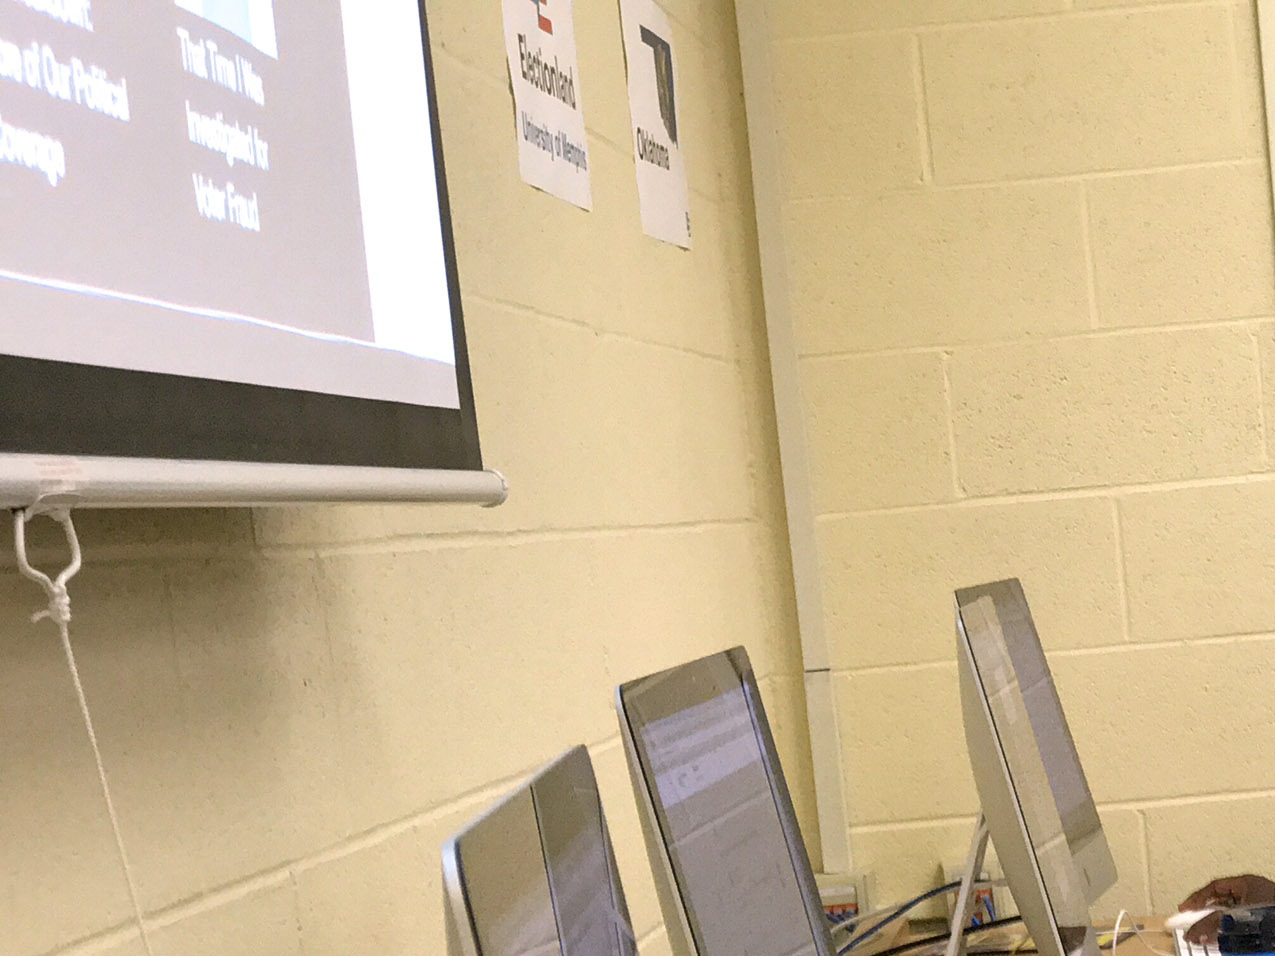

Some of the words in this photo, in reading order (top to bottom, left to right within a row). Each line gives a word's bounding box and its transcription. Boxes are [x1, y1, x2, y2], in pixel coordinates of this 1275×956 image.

[22, 41, 42, 90] of
[42, 44, 71, 101] Our
[71, 56, 130, 122] Political
[176, 27, 208, 79] That
[206, 39, 237, 92] Time
[241, 56, 265, 107] Was
[517, 33, 577, 110] Electionland
[185, 99, 255, 168] Investigated
[253, 127, 269, 171] for
[521, 110, 555, 161] University
[637, 126, 670, 171] Oklahoma
[191, 172, 226, 223] Voter
[225, 181, 261, 232] Fraud
